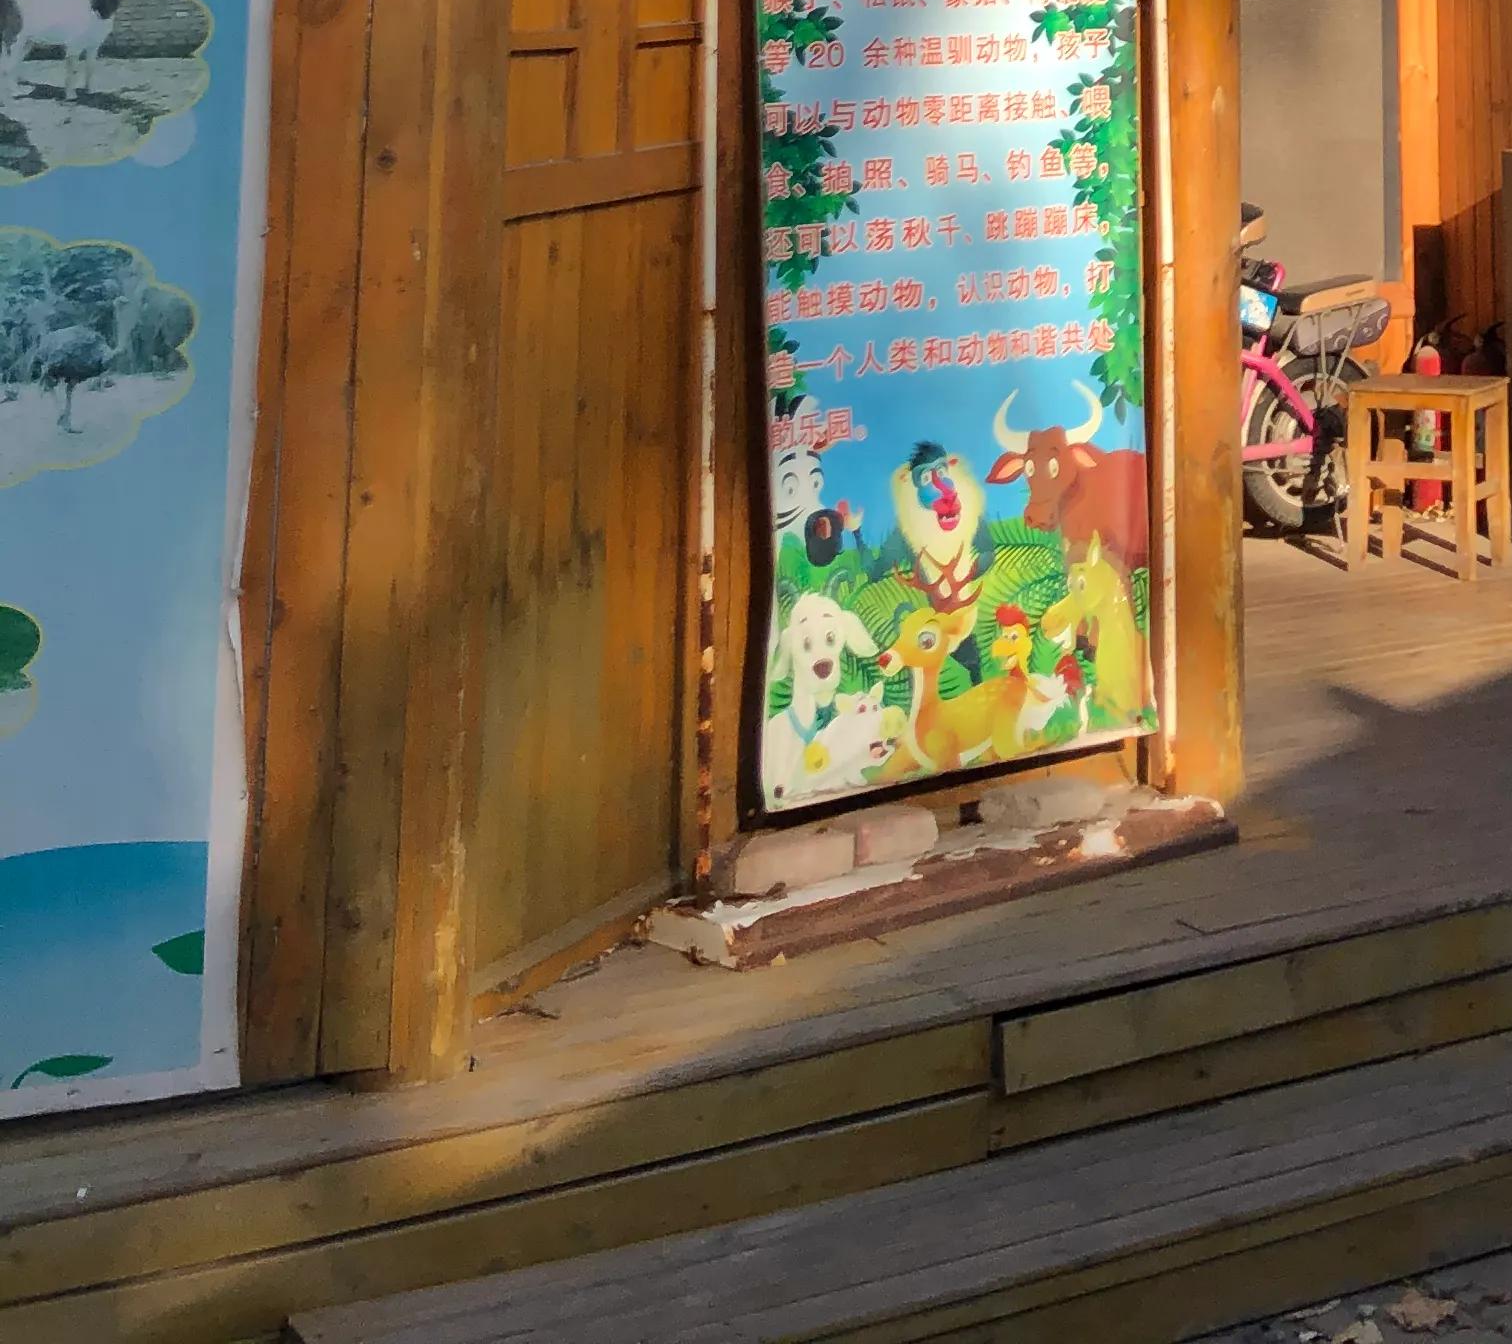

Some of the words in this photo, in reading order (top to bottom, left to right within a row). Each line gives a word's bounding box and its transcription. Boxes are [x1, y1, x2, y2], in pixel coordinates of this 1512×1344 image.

[763, 84, 1112, 137] 可以与动物零距离接触、喂
[766, 318, 1116, 390] 造一个人类和动物和谐共处
[769, 406, 868, 451] 的乐园。
